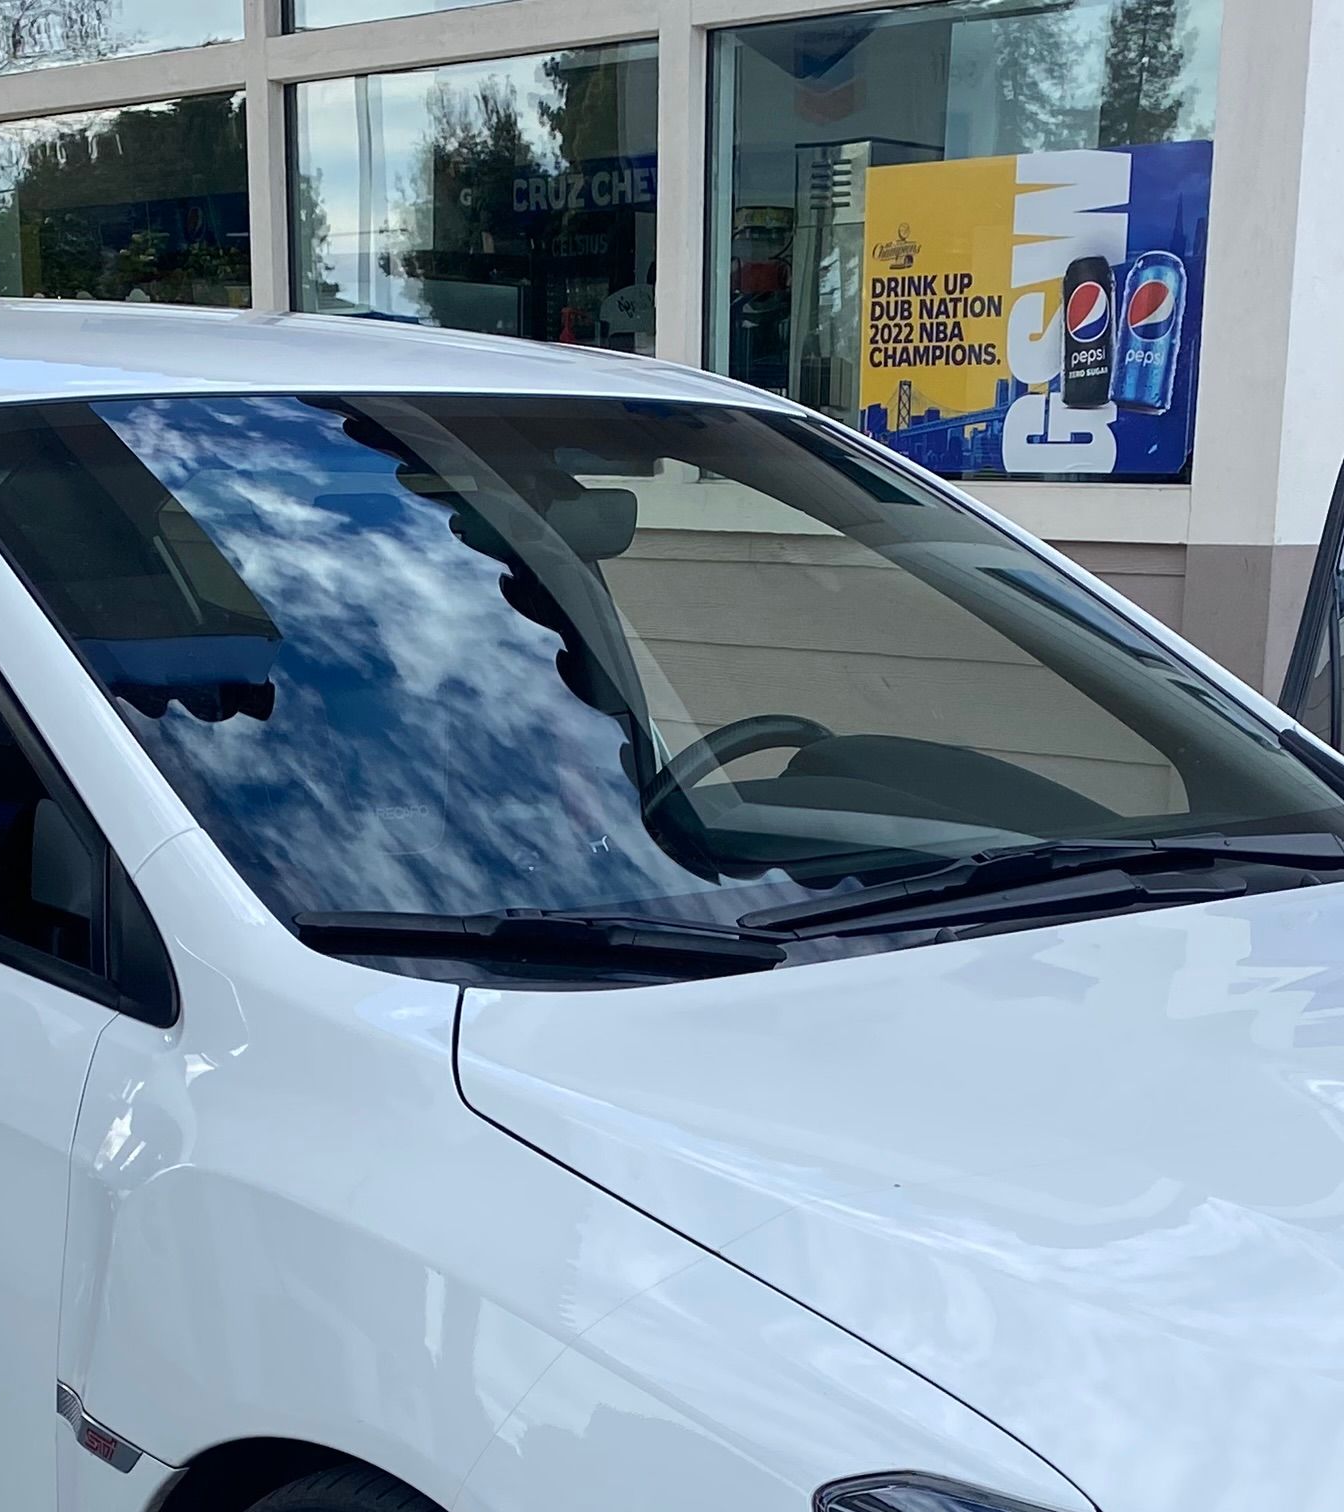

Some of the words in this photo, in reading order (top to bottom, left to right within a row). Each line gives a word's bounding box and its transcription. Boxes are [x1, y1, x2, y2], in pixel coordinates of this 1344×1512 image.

[513, 174, 585, 212] CRUZ
[552, 233, 608, 256] CELSIUS
[871, 274, 937, 299] DRINK
[944, 273, 973, 295] UP
[870, 299, 913, 322] DUB
[919, 295, 1002, 320] NATION
[869, 322, 914, 344] 2022
[919, 321, 964, 343] NBA
[869, 343, 1001, 368] CHAMPIONS.
[1071, 345, 1106, 368] pepsi
[1069, 369, 1086, 379] ZERO
